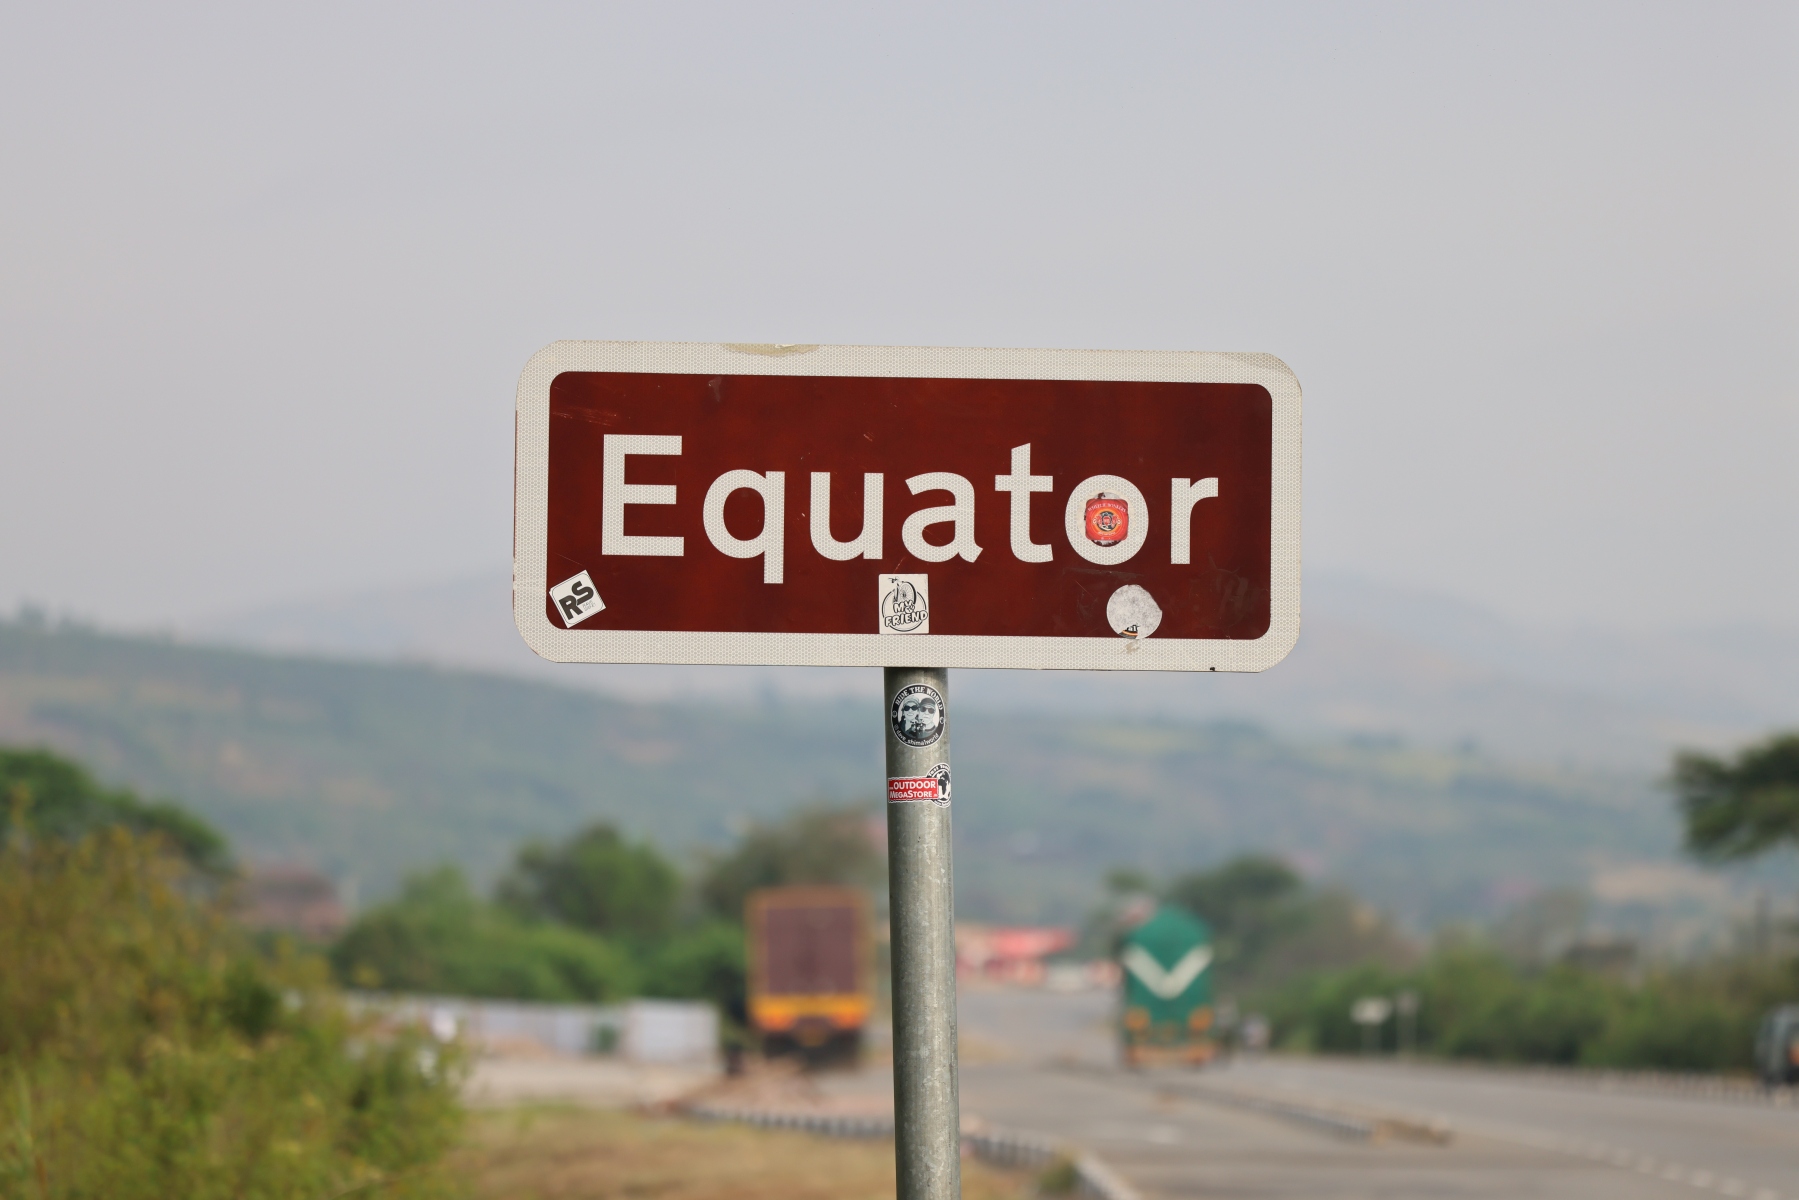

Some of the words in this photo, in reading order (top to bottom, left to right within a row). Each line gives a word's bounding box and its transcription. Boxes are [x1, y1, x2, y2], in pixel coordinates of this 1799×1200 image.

[601, 434, 1218, 585] Equator
[558, 580, 594, 620] RS
[893, 600, 914, 614] MY
[885, 610, 928, 627] FRIEND
[895, 689, 910, 706] RIDE
[909, 686, 926, 694] THE
[926, 688, 944, 710] WORLD
